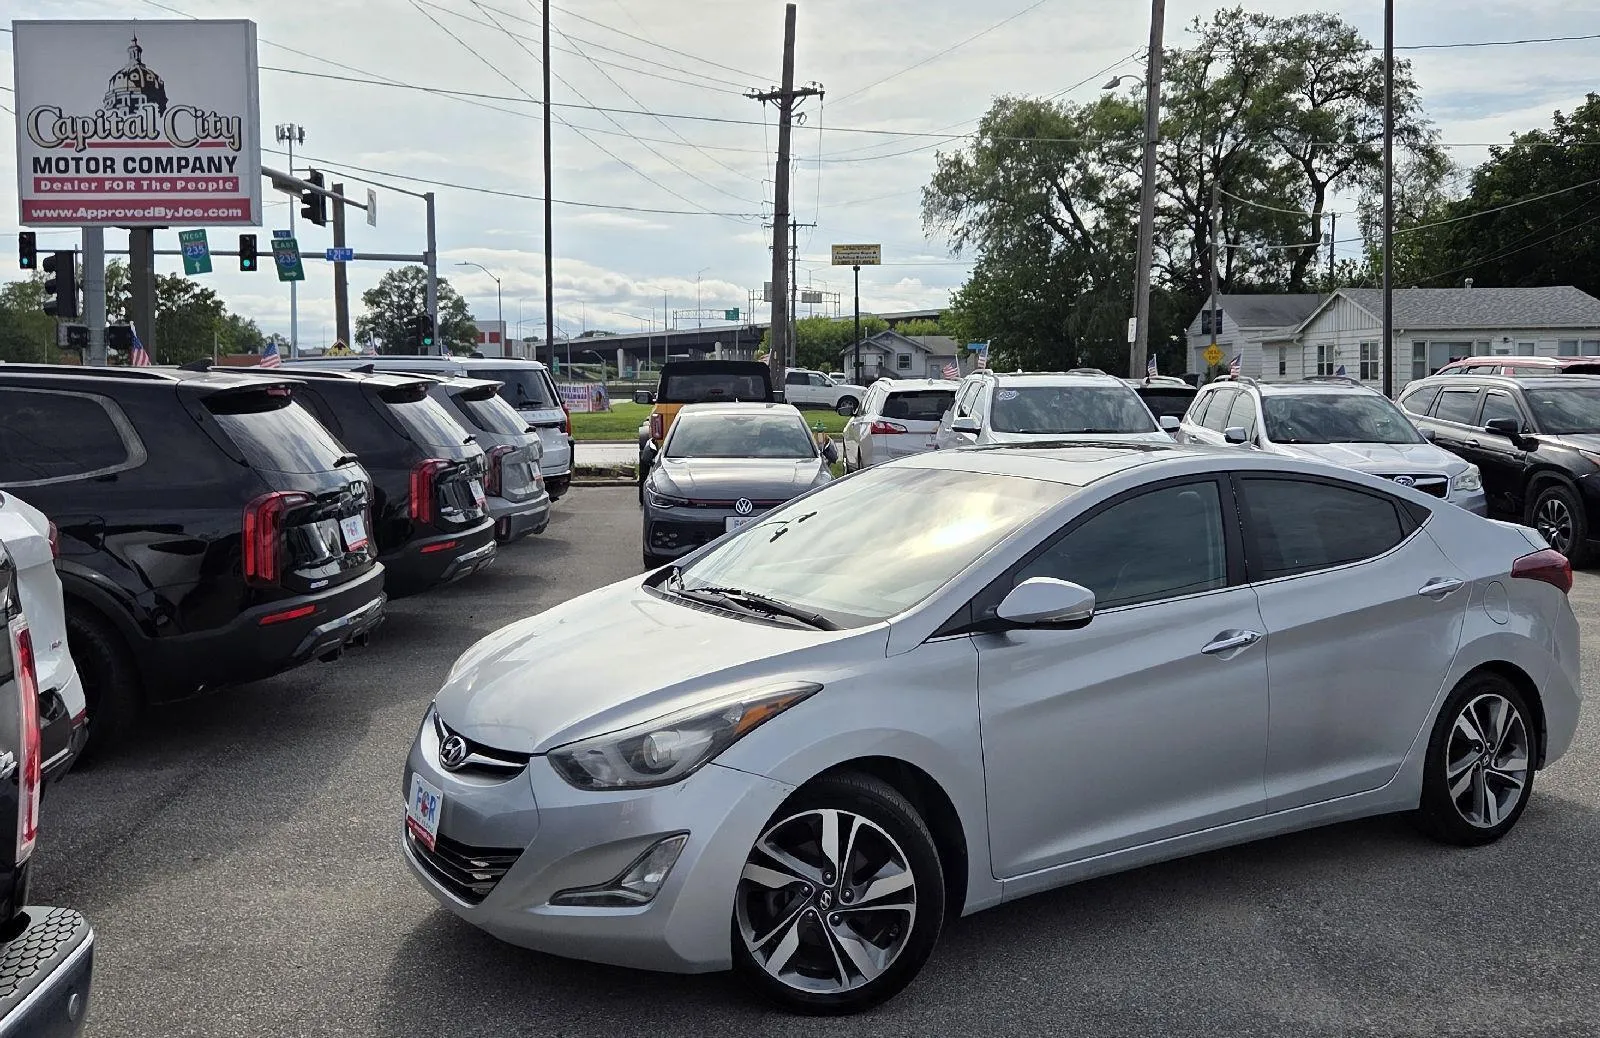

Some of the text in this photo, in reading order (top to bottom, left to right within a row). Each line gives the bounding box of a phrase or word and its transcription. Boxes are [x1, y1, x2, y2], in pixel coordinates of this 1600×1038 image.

[27, 104, 242, 152] Capital City
[32, 155, 238, 174] MOTOR COMPANY
[40, 179, 234, 192] Dealer FOR The People
[31, 206, 242, 220] www.ApprovedByJoe.com
[186, 245, 205, 256] 235
[279, 253, 297, 264] 235
